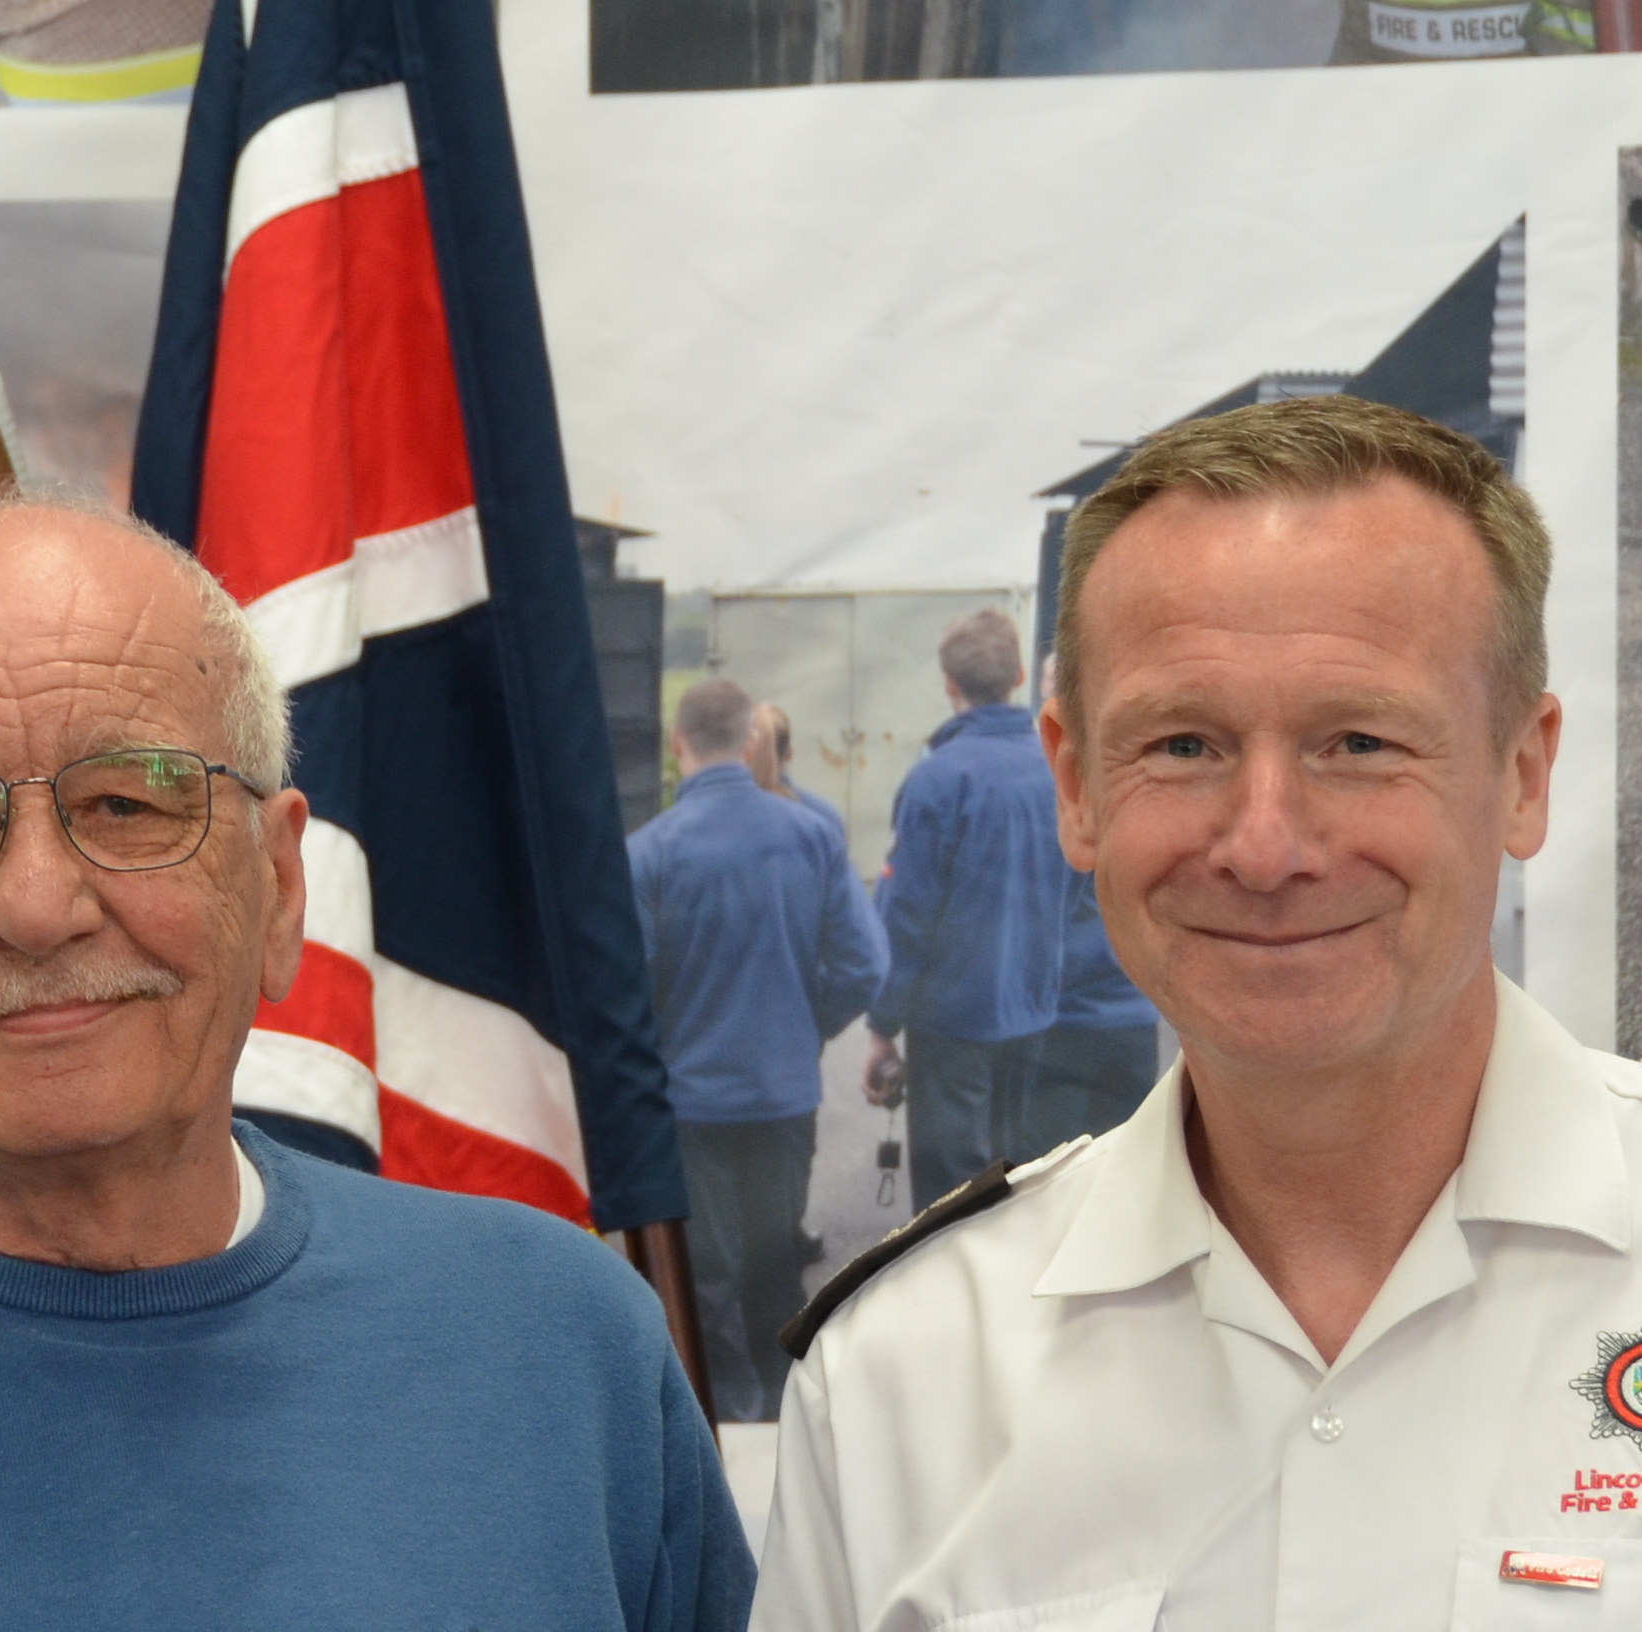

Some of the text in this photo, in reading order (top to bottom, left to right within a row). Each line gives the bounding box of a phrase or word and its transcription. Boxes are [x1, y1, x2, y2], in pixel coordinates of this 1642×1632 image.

[1377, 14, 1417, 41] FIRE
[1427, 20, 1441, 41] &
[1561, 1492, 1611, 1513] Fire
[1618, 1490, 1638, 1510] &
